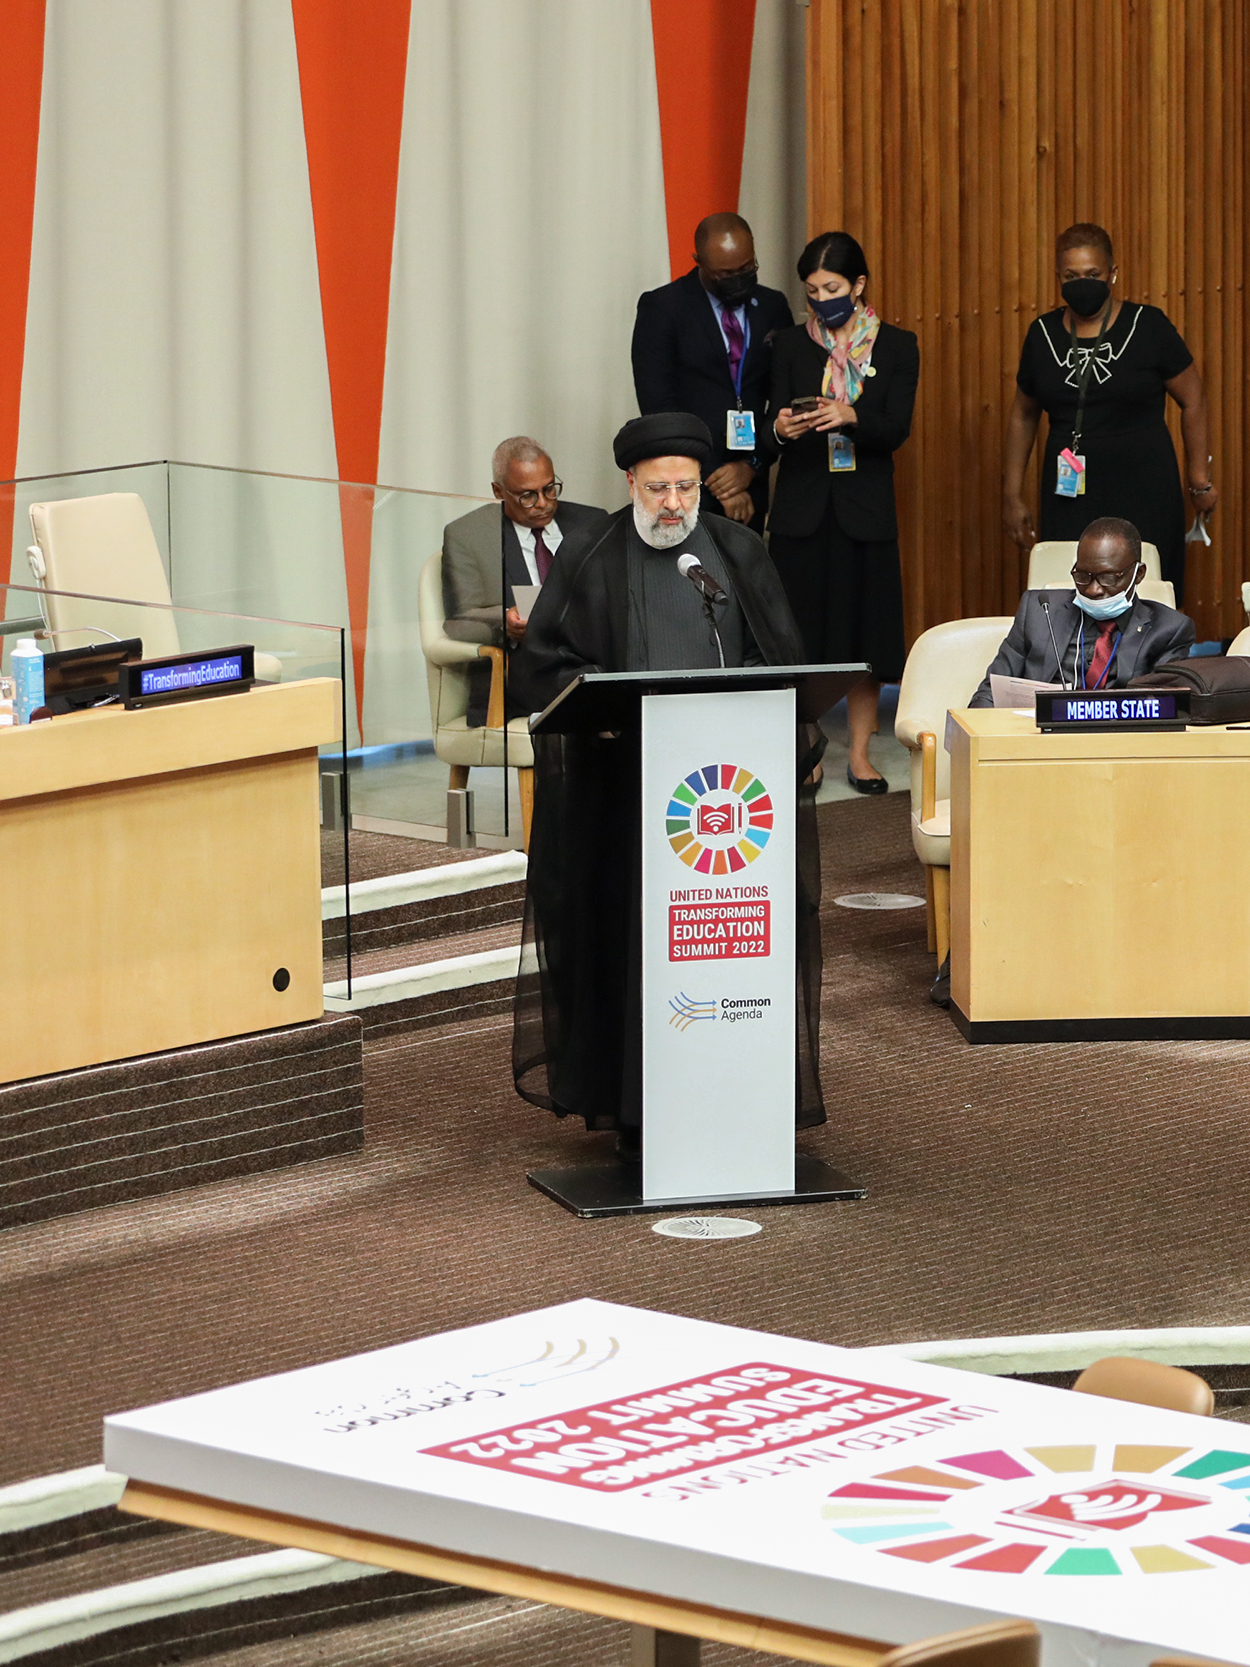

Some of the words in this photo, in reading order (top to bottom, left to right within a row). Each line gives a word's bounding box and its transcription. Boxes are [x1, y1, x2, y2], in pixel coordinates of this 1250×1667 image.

[143, 660, 240, 690] #TransformingEducation
[1067, 701, 1119, 720] MEMBER
[1121, 699, 1160, 718] STATE
[669, 889, 713, 902] UNITED
[715, 885, 769, 899] NATIONS
[673, 905, 765, 922] TRANSFORMING
[673, 921, 765, 940] EDUCATION
[673, 943, 728, 957] SUMMIT
[732, 941, 765, 954] 2022
[720, 998, 771, 1009] Common
[720, 1009, 763, 1023] Agenda
[323, 1389, 506, 1433] Common
[587, 1367, 791, 1426] SUMMIT
[449, 1419, 592, 1459] 2022
[510, 1378, 866, 1474] EDUCATION
[580, 1393, 922, 1485] TRANSFORMING
[837, 1404, 999, 1450] UNITED
[641, 1448, 848, 1501] NATIONS
